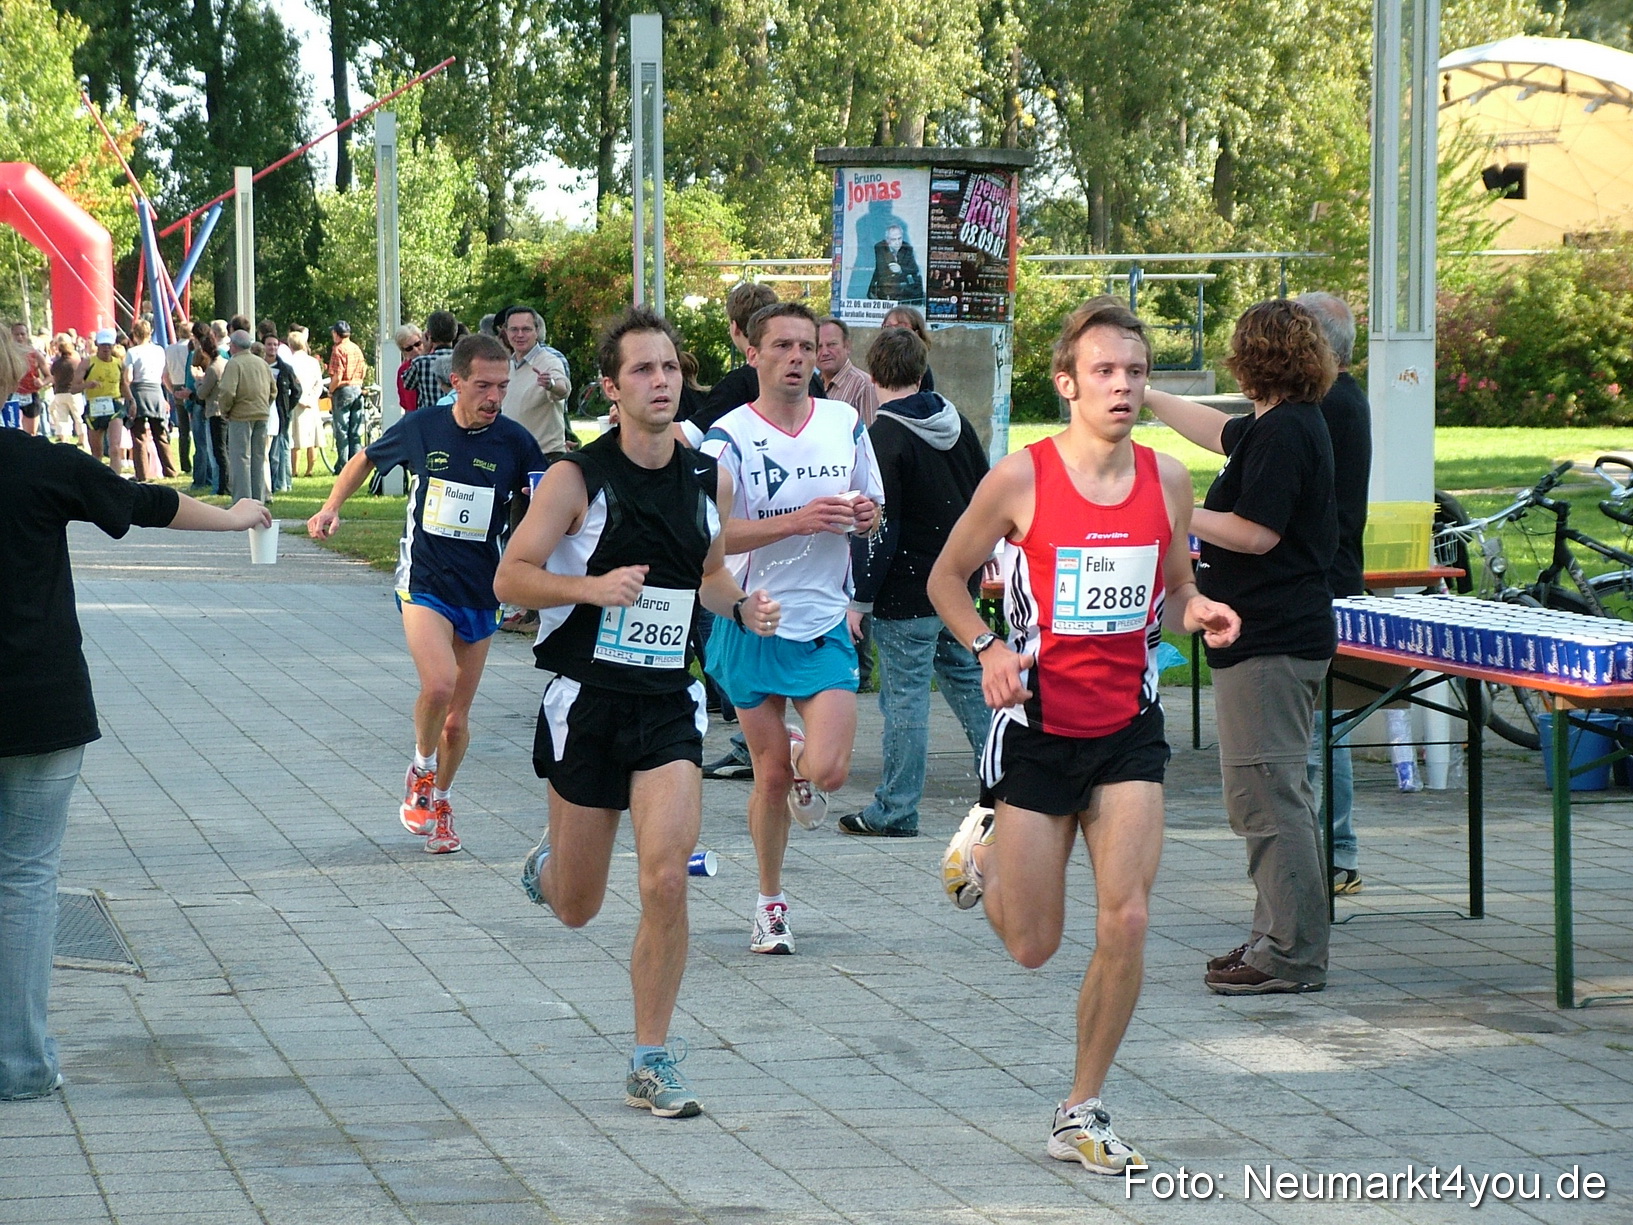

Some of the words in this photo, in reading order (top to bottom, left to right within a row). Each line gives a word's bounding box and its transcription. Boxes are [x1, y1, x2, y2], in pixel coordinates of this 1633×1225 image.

[854, 172, 882, 183] Bruno
[848, 179, 902, 211] Jonas
[796, 465, 848, 480] PLAST
[445, 486, 475, 502] Roland
[428, 498, 433, 507] A
[459, 509, 470, 524] 6
[1086, 556, 1116, 573] Felix
[1060, 581, 1066, 594] A
[631, 592, 671, 612] Marco
[1086, 584, 1147, 610] 2888
[605, 611, 612, 623] A
[627, 621, 684, 646] 2862
